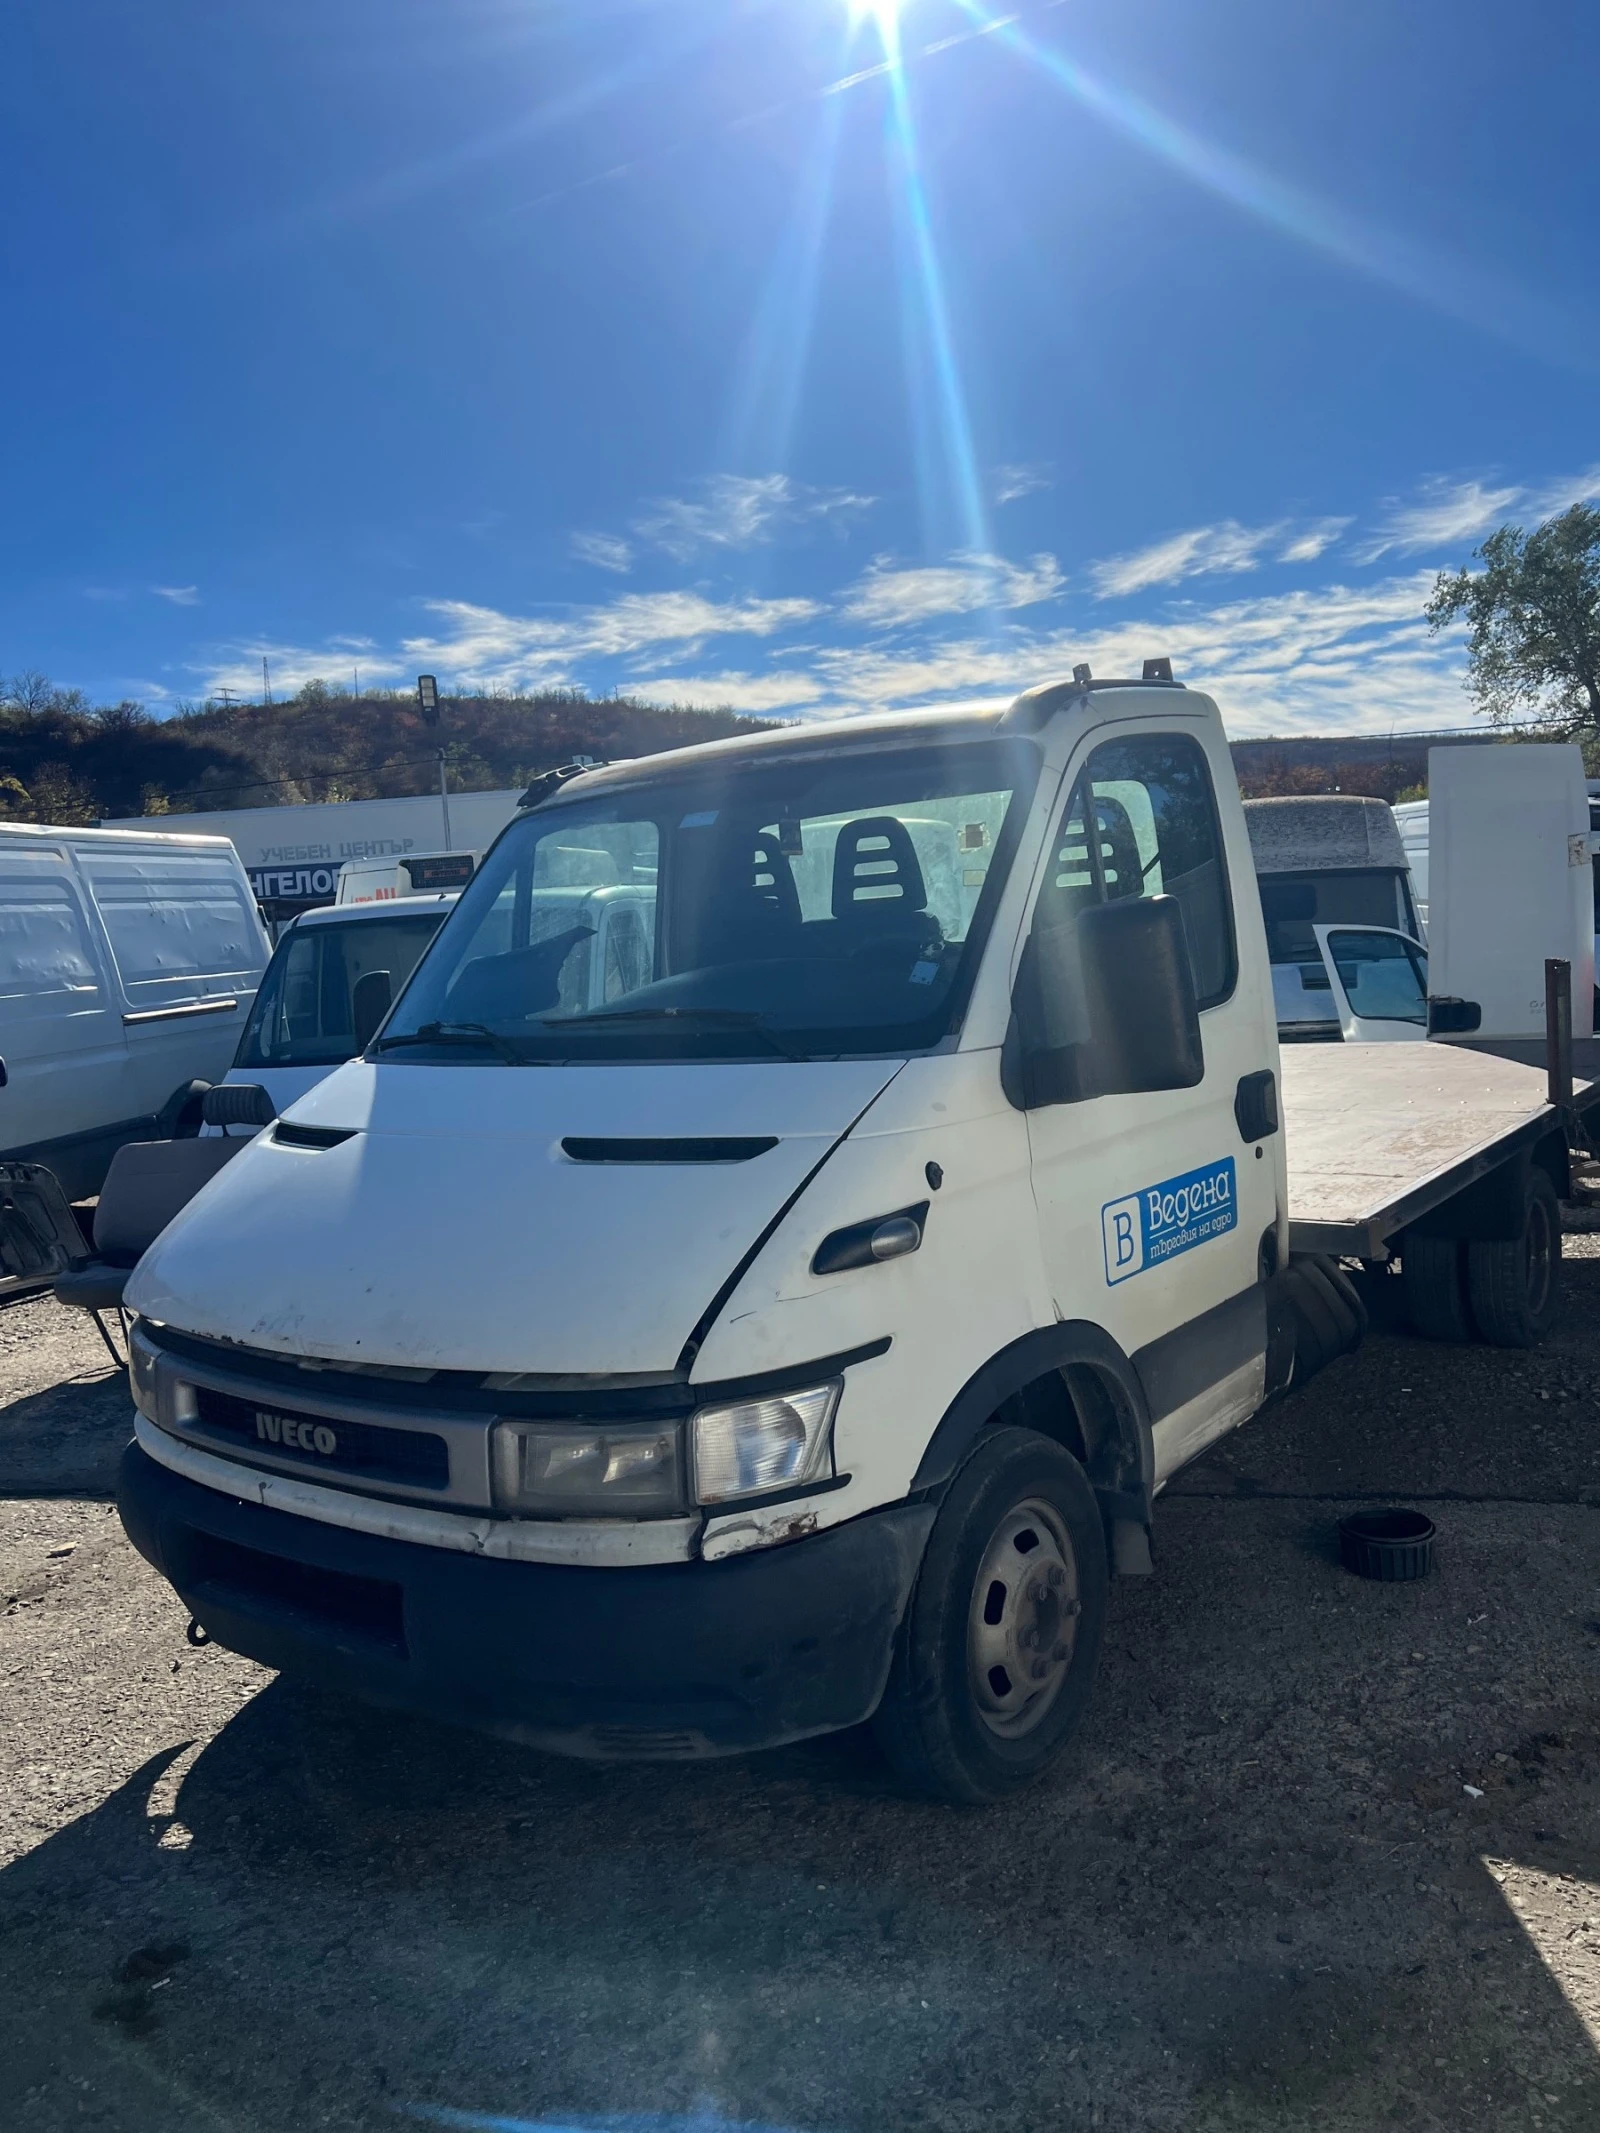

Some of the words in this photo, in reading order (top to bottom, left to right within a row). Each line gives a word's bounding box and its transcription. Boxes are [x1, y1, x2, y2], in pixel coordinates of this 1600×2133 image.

[260, 843, 331, 862] УЧЕБЕН
[340, 838, 414, 858] ЦЕНТЪР
[1147, 1171, 1230, 1231] Ведена
[1150, 1229, 1197, 1259] търговия
[1199, 1221, 1211, 1236] на
[1212, 1212, 1232, 1232] едро
[256, 1412, 336, 1454] IVECO
